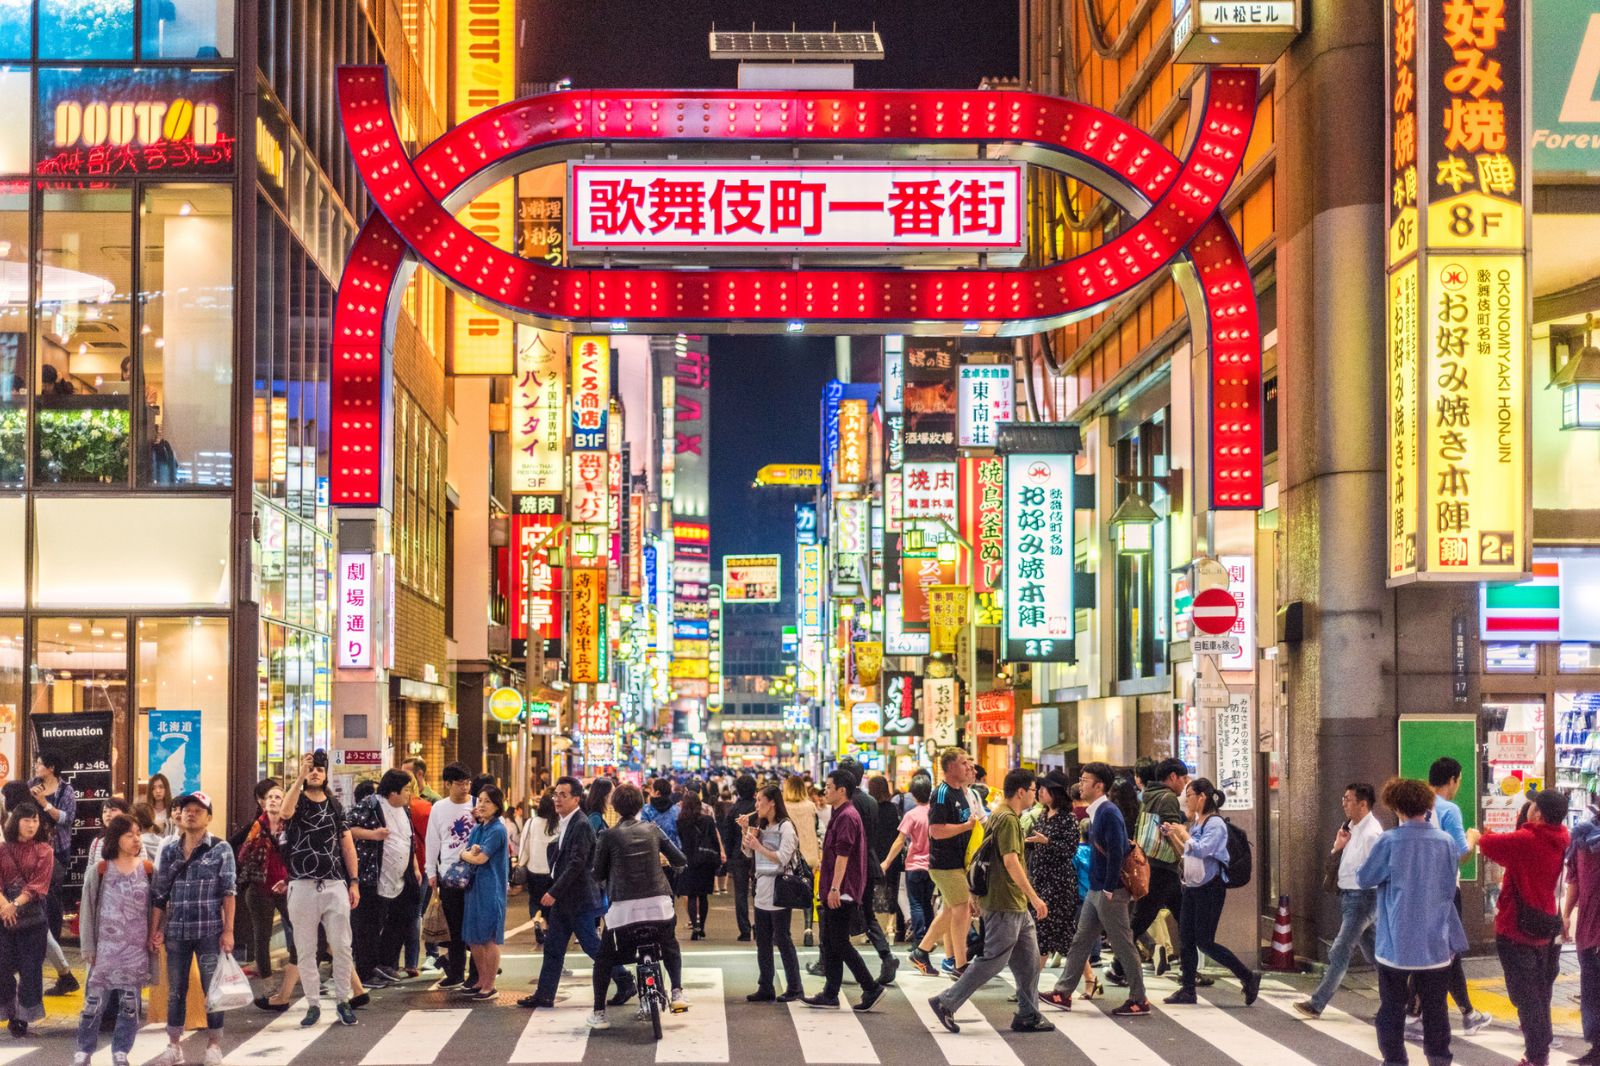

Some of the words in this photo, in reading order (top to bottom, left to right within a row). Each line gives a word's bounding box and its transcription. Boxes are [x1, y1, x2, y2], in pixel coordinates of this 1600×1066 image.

[1215, 5, 1279, 23] 小松ビル
[1443, 0, 1506, 153] 好み焼
[55, 98, 219, 146] DOUTOR
[1437, 154, 1516, 195] 本陣
[588, 178, 1006, 238] 歌舞伎町一番街
[1448, 205, 1503, 238] 8F
[1398, 217, 1413, 249] 8F
[1477, 269, 1491, 355] 歌舞伎町名物
[1498, 269, 1511, 391] OKONOMIYAKI
[580, 342, 600, 427] まぐろ商店
[519, 371, 543, 457] バンタイ
[972, 382, 989, 444] 東南荘
[1436, 292, 1470, 534] お好み焼き本陣
[575, 434, 605, 448] B1F
[1498, 397, 1511, 463] HONJIN
[527, 477, 547, 488] 3F
[519, 495, 555, 514] 焼肉
[979, 460, 1003, 588] 焼鳥釜めし
[1405, 538, 1416, 563] 2F
[1481, 535, 1513, 562] 2F
[346, 562, 366, 658] 劇場通り
[1025, 640, 1054, 656] 2F
[1194, 641, 1236, 652] 自転車を除く
[1456, 682, 1466, 691] 17
[42, 726, 103, 738] information
[157, 721, 193, 733] 北海道
[1230, 703, 1241, 791] 防犯カメラ作動中
[1240, 698, 1249, 796] みなさまの安全を守ります
[73, 762, 84, 770] 4F
[74, 790, 84, 798] 3F
[77, 848, 86, 856] 1F
